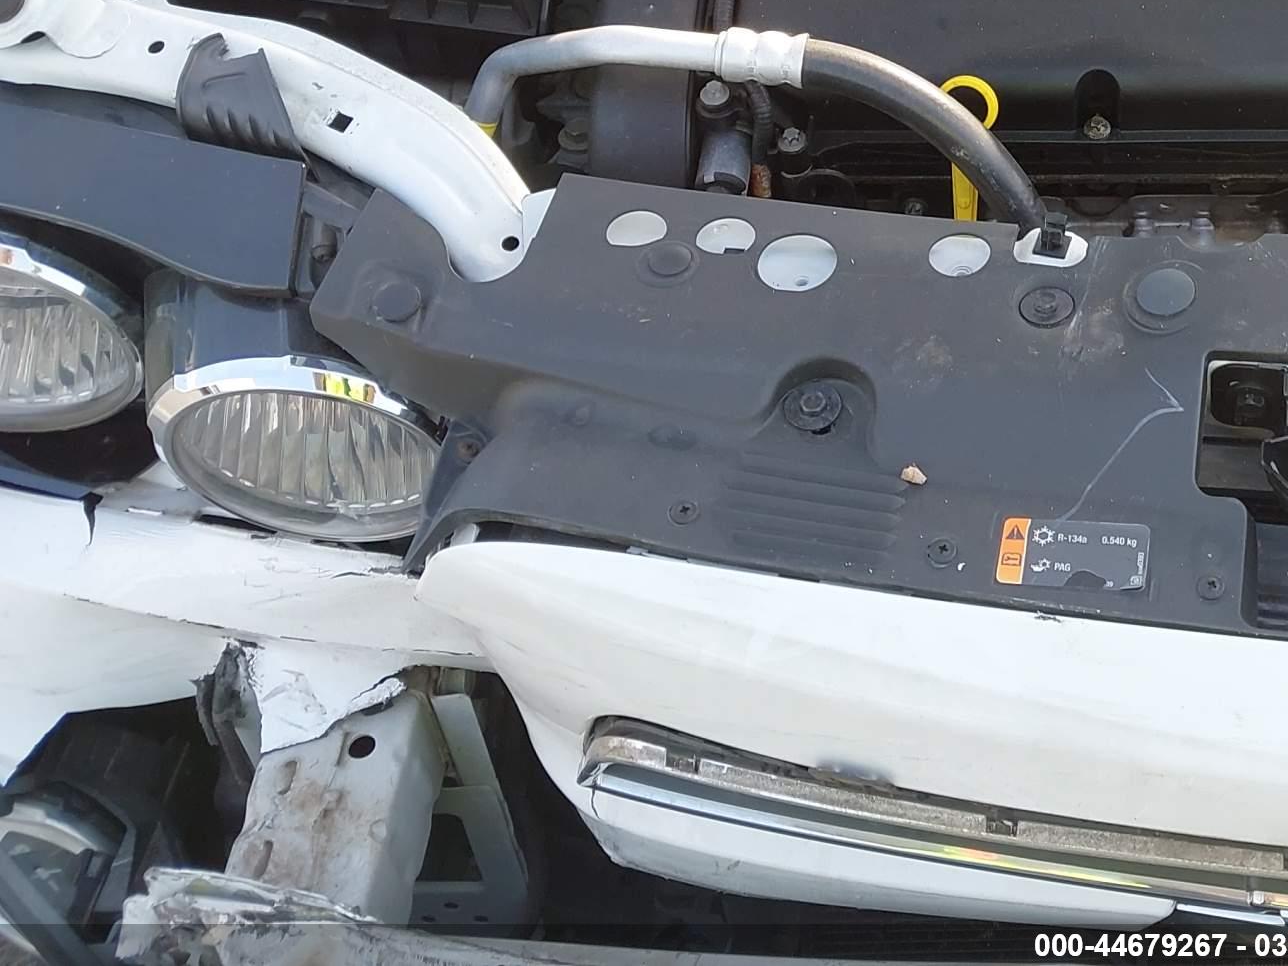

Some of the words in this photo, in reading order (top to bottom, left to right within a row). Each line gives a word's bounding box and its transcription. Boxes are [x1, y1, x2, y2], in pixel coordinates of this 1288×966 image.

[1057, 533, 1088, 545] R-134a
[1101, 536, 1126, 546] 0.540
[1127, 538, 1137, 548] kg
[1054, 562, 1072, 573] PAG
